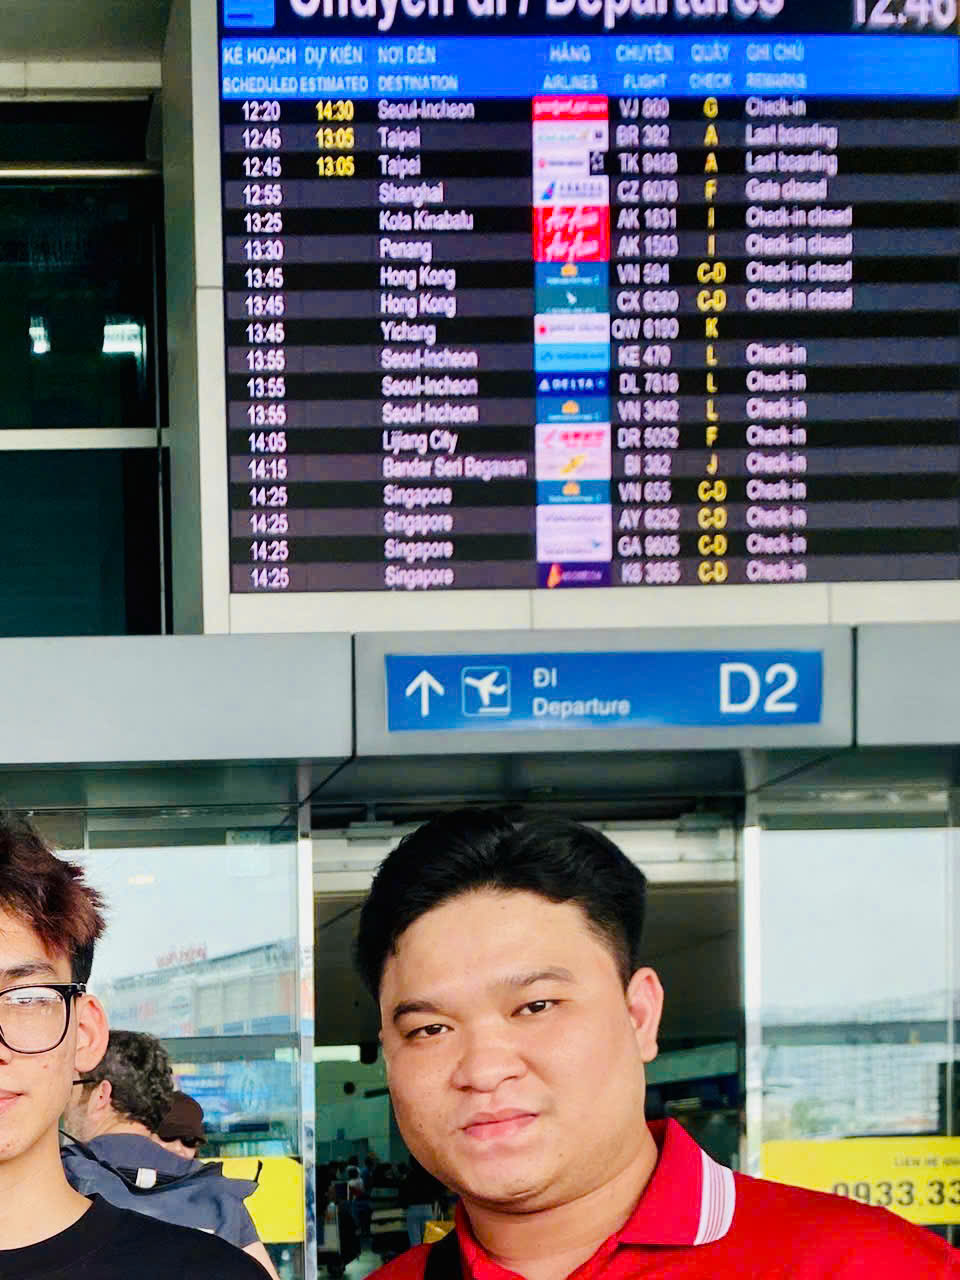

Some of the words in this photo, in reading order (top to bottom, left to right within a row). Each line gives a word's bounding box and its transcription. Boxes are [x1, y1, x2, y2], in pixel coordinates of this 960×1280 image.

[247, 47, 296, 69] HOẠCH
[223, 77, 298, 93] SCHEDULED
[300, 76, 368, 92] ESTIMATED
[377, 75, 458, 91] DESTINATION
[243, 101, 280, 121] 12:20
[316, 100, 354, 120] 14:30
[316, 128, 355, 149] 13:05
[316, 156, 355, 177] 13:05
[243, 184, 282, 205] 12:55
[618, 181, 639, 202] CZ
[245, 213, 282, 232] 13:25
[245, 240, 283, 260] 13:30
[246, 268, 283, 288] 13:45
[380, 266, 416, 290] Hong
[419, 266, 456, 290] Kong
[246, 296, 284, 315] 13:45
[380, 294, 416, 318] Hong
[419, 294, 457, 318] Kong
[247, 323, 284, 343] 13:45
[249, 432, 286, 452] 14:05
[250, 487, 287, 506] 14:25
[384, 485, 453, 509] Singapore
[250, 514, 288, 534] 14:25
[384, 511, 453, 535] Singapore
[252, 541, 288, 561] 14:25
[384, 539, 453, 563] Singapore
[252, 568, 289, 588] 14:25
[384, 566, 453, 590] Singapore
[719, 662, 798, 714] D2
[532, 697, 631, 718] Departure
